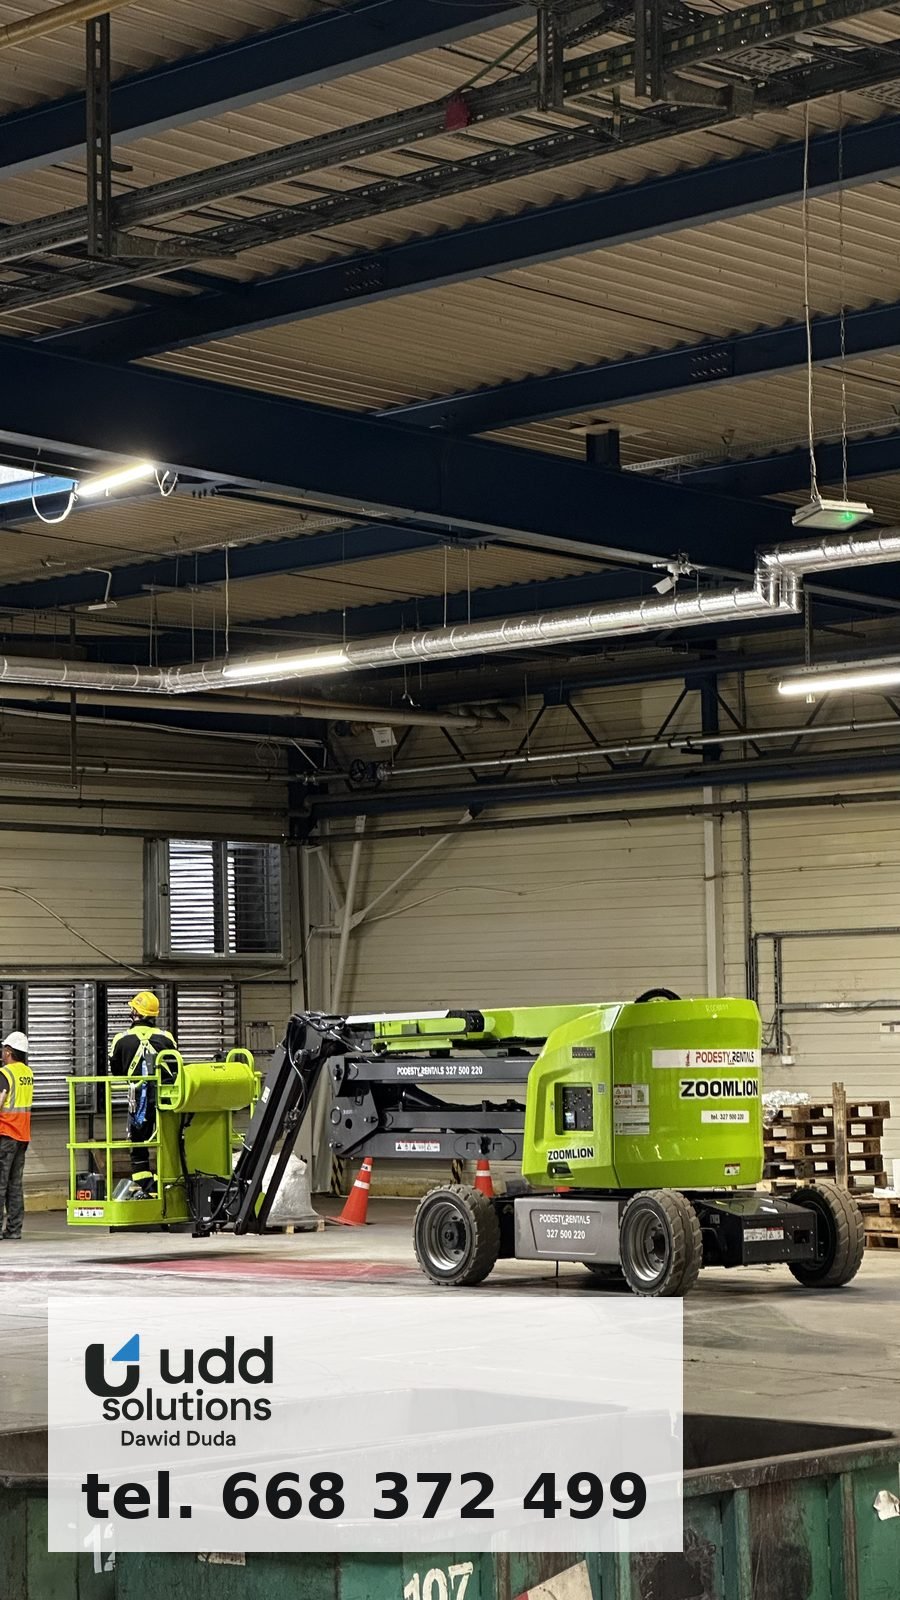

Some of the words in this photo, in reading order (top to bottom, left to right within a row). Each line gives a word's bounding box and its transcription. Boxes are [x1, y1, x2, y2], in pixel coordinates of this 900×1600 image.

[445, 1066, 457, 1075] 327
[458, 1066, 470, 1075] 500
[470, 1066, 483, 1075] 220
[681, 1080, 758, 1097] ZOOMLION
[547, 1147, 594, 1160] ZOOMLION
[546, 1229, 558, 1238] 327
[560, 1229, 572, 1239] 500
[573, 1230, 586, 1239] 220
[403, 1561, 474, 1600] 107
